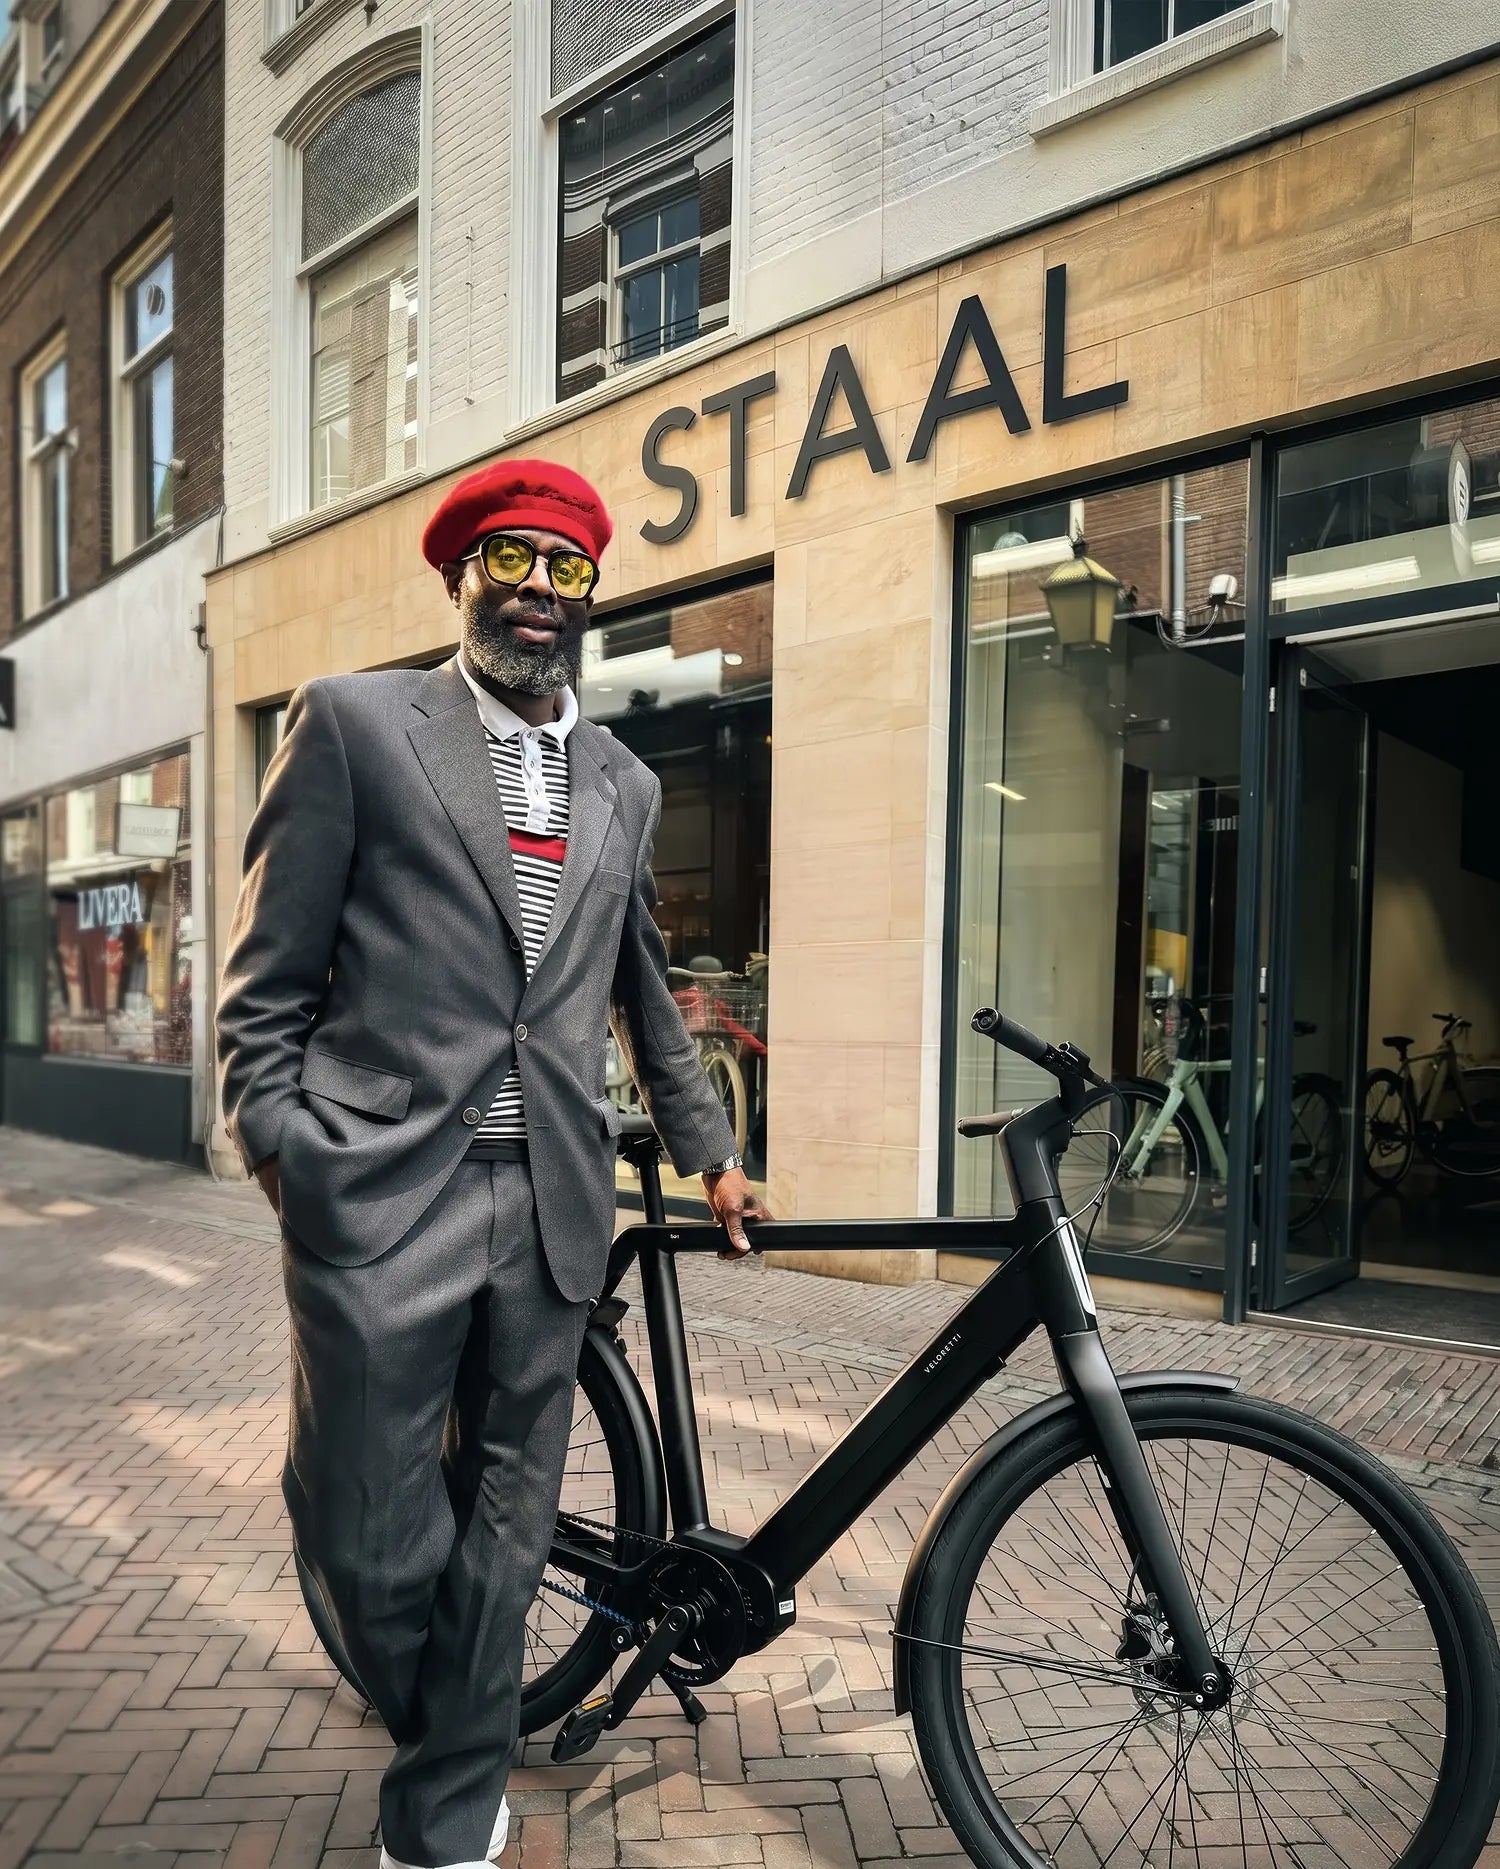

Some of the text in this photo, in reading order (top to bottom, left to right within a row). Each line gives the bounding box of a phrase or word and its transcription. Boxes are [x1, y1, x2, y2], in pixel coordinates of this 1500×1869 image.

[639, 263, 1130, 544] STAAL
[78, 881, 144, 930] LIVERA
[923, 1333, 962, 1374] VELORETTI
